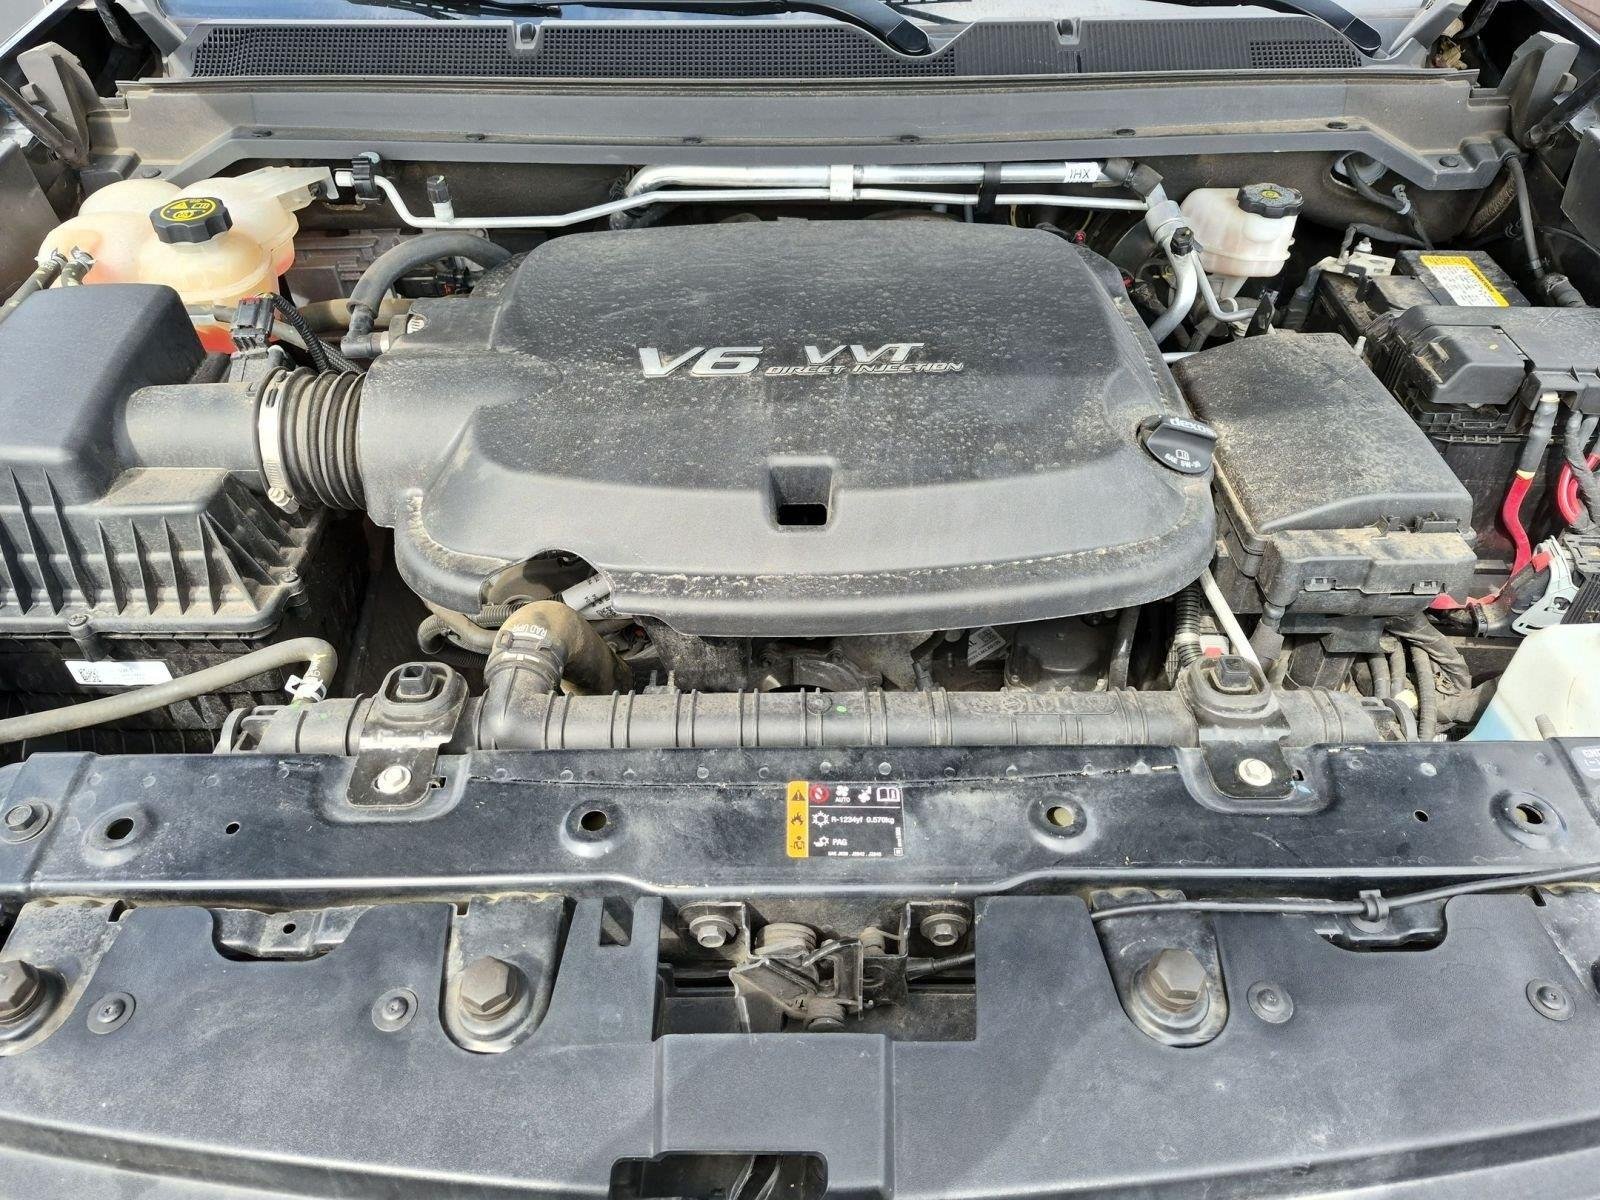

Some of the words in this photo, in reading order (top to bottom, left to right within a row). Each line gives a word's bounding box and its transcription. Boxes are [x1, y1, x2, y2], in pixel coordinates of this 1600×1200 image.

[639, 346, 763, 376] V6
[804, 343, 925, 366] VVT
[765, 364, 847, 376] DIRECT
[853, 362, 965, 374] INJECTION
[530, 624, 548, 636] RAD
[831, 816, 864, 825] R-1234yf
[866, 816, 895, 825] 0.570kg
[832, 838, 848, 846] PAG
